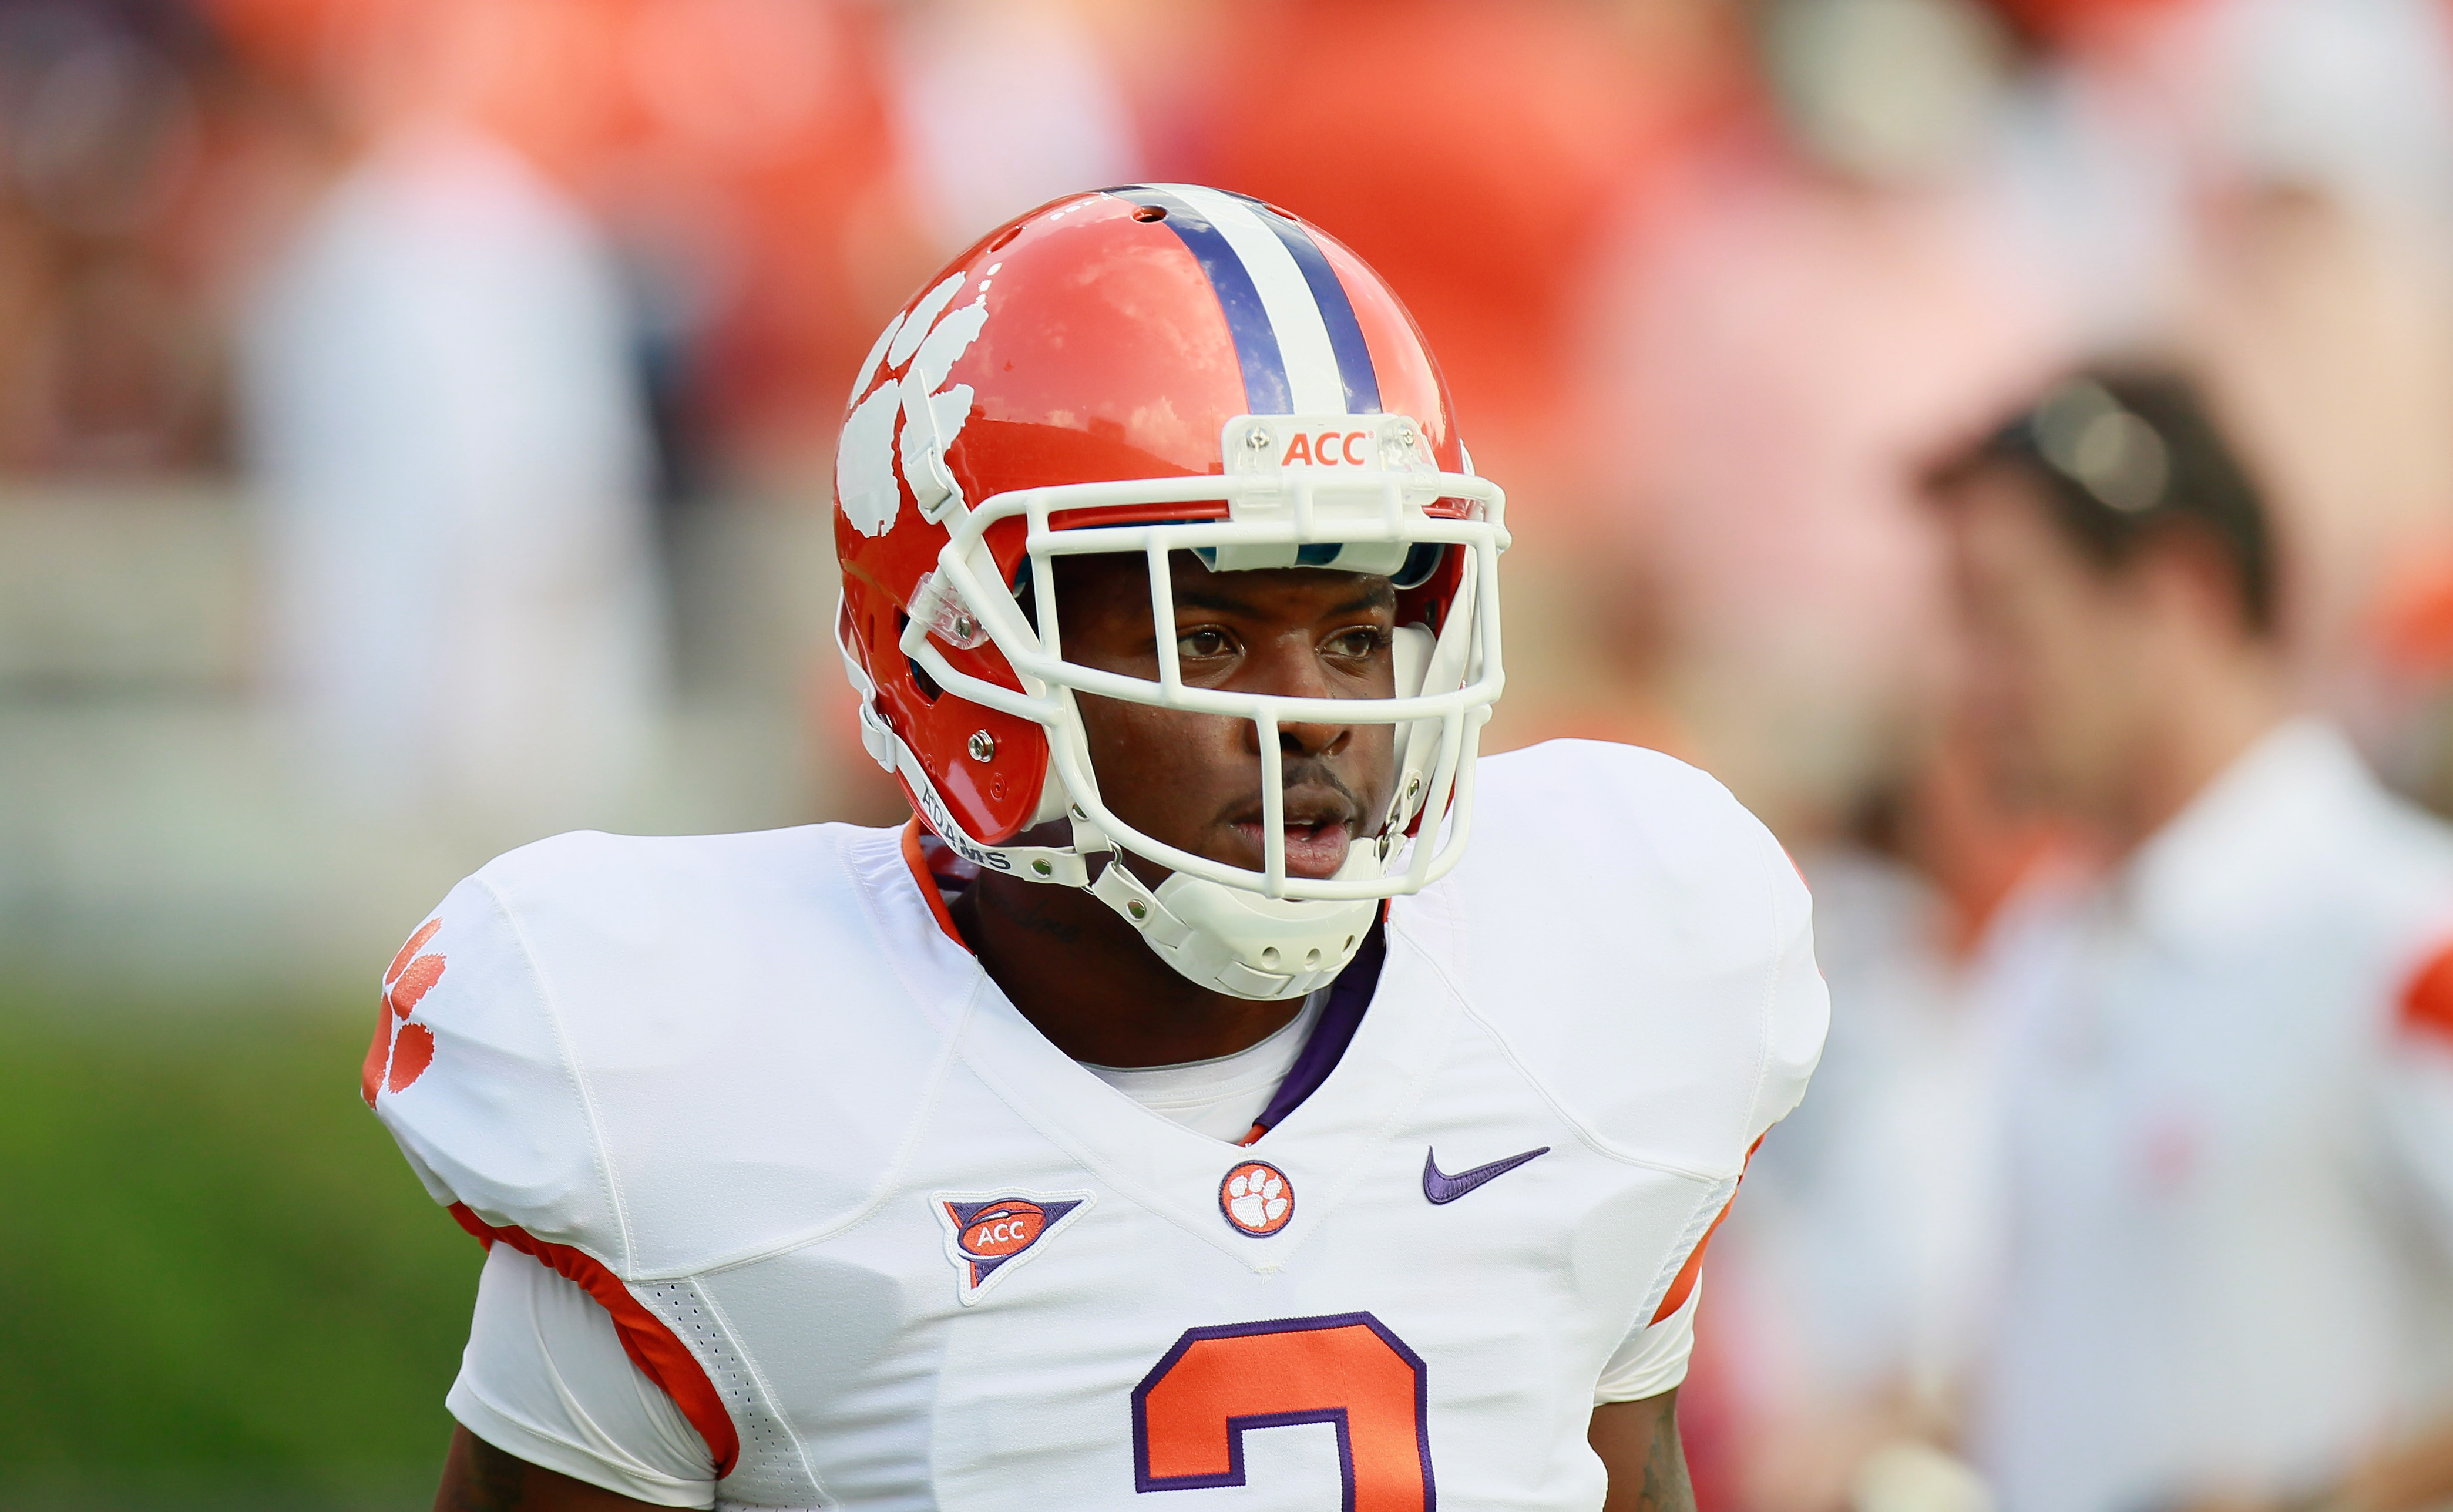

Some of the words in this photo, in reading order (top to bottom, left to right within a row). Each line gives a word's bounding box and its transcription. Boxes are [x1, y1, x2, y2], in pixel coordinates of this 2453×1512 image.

[1282, 432, 1366, 466] ACC
[922, 780, 1012, 870] ADAMS
[977, 1221, 1024, 1246] ACC
